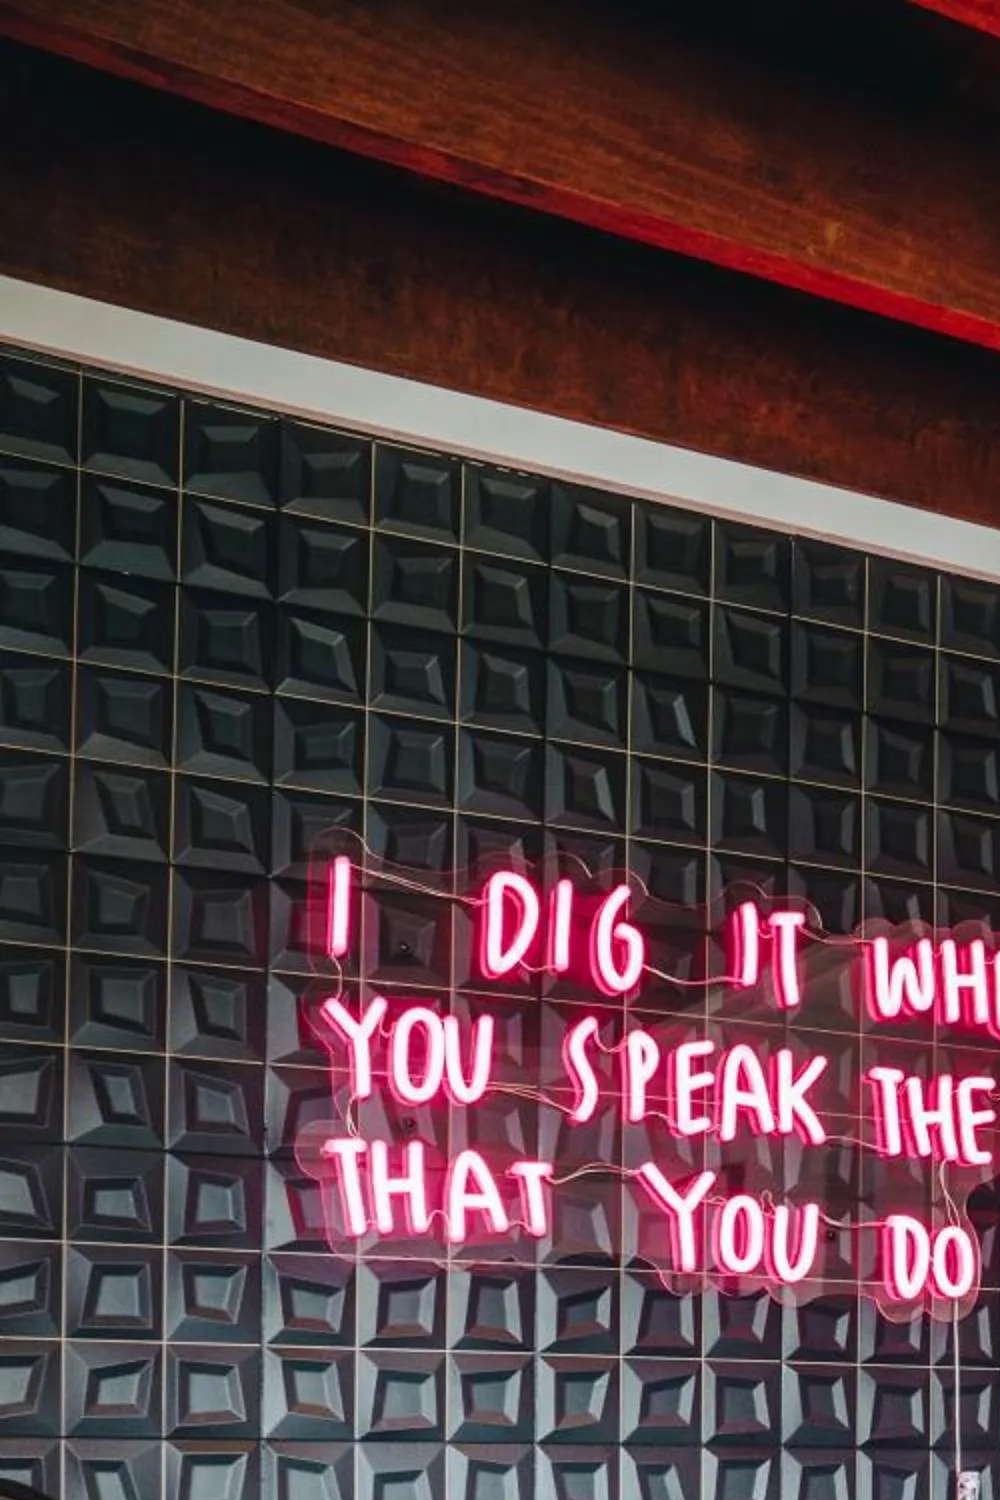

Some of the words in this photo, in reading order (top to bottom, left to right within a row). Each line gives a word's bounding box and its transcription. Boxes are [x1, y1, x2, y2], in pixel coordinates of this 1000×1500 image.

[321, 854, 352, 960] I
[480, 869, 645, 998] DIG
[732, 900, 808, 1008] IT
[322, 996, 494, 1106] YOU
[563, 1014, 828, 1146] SPEAK
[866, 1064, 998, 1168] THE
[320, 1134, 554, 1244] THAT
[638, 1160, 820, 1284] YOU
[882, 1212, 978, 1300] DO
